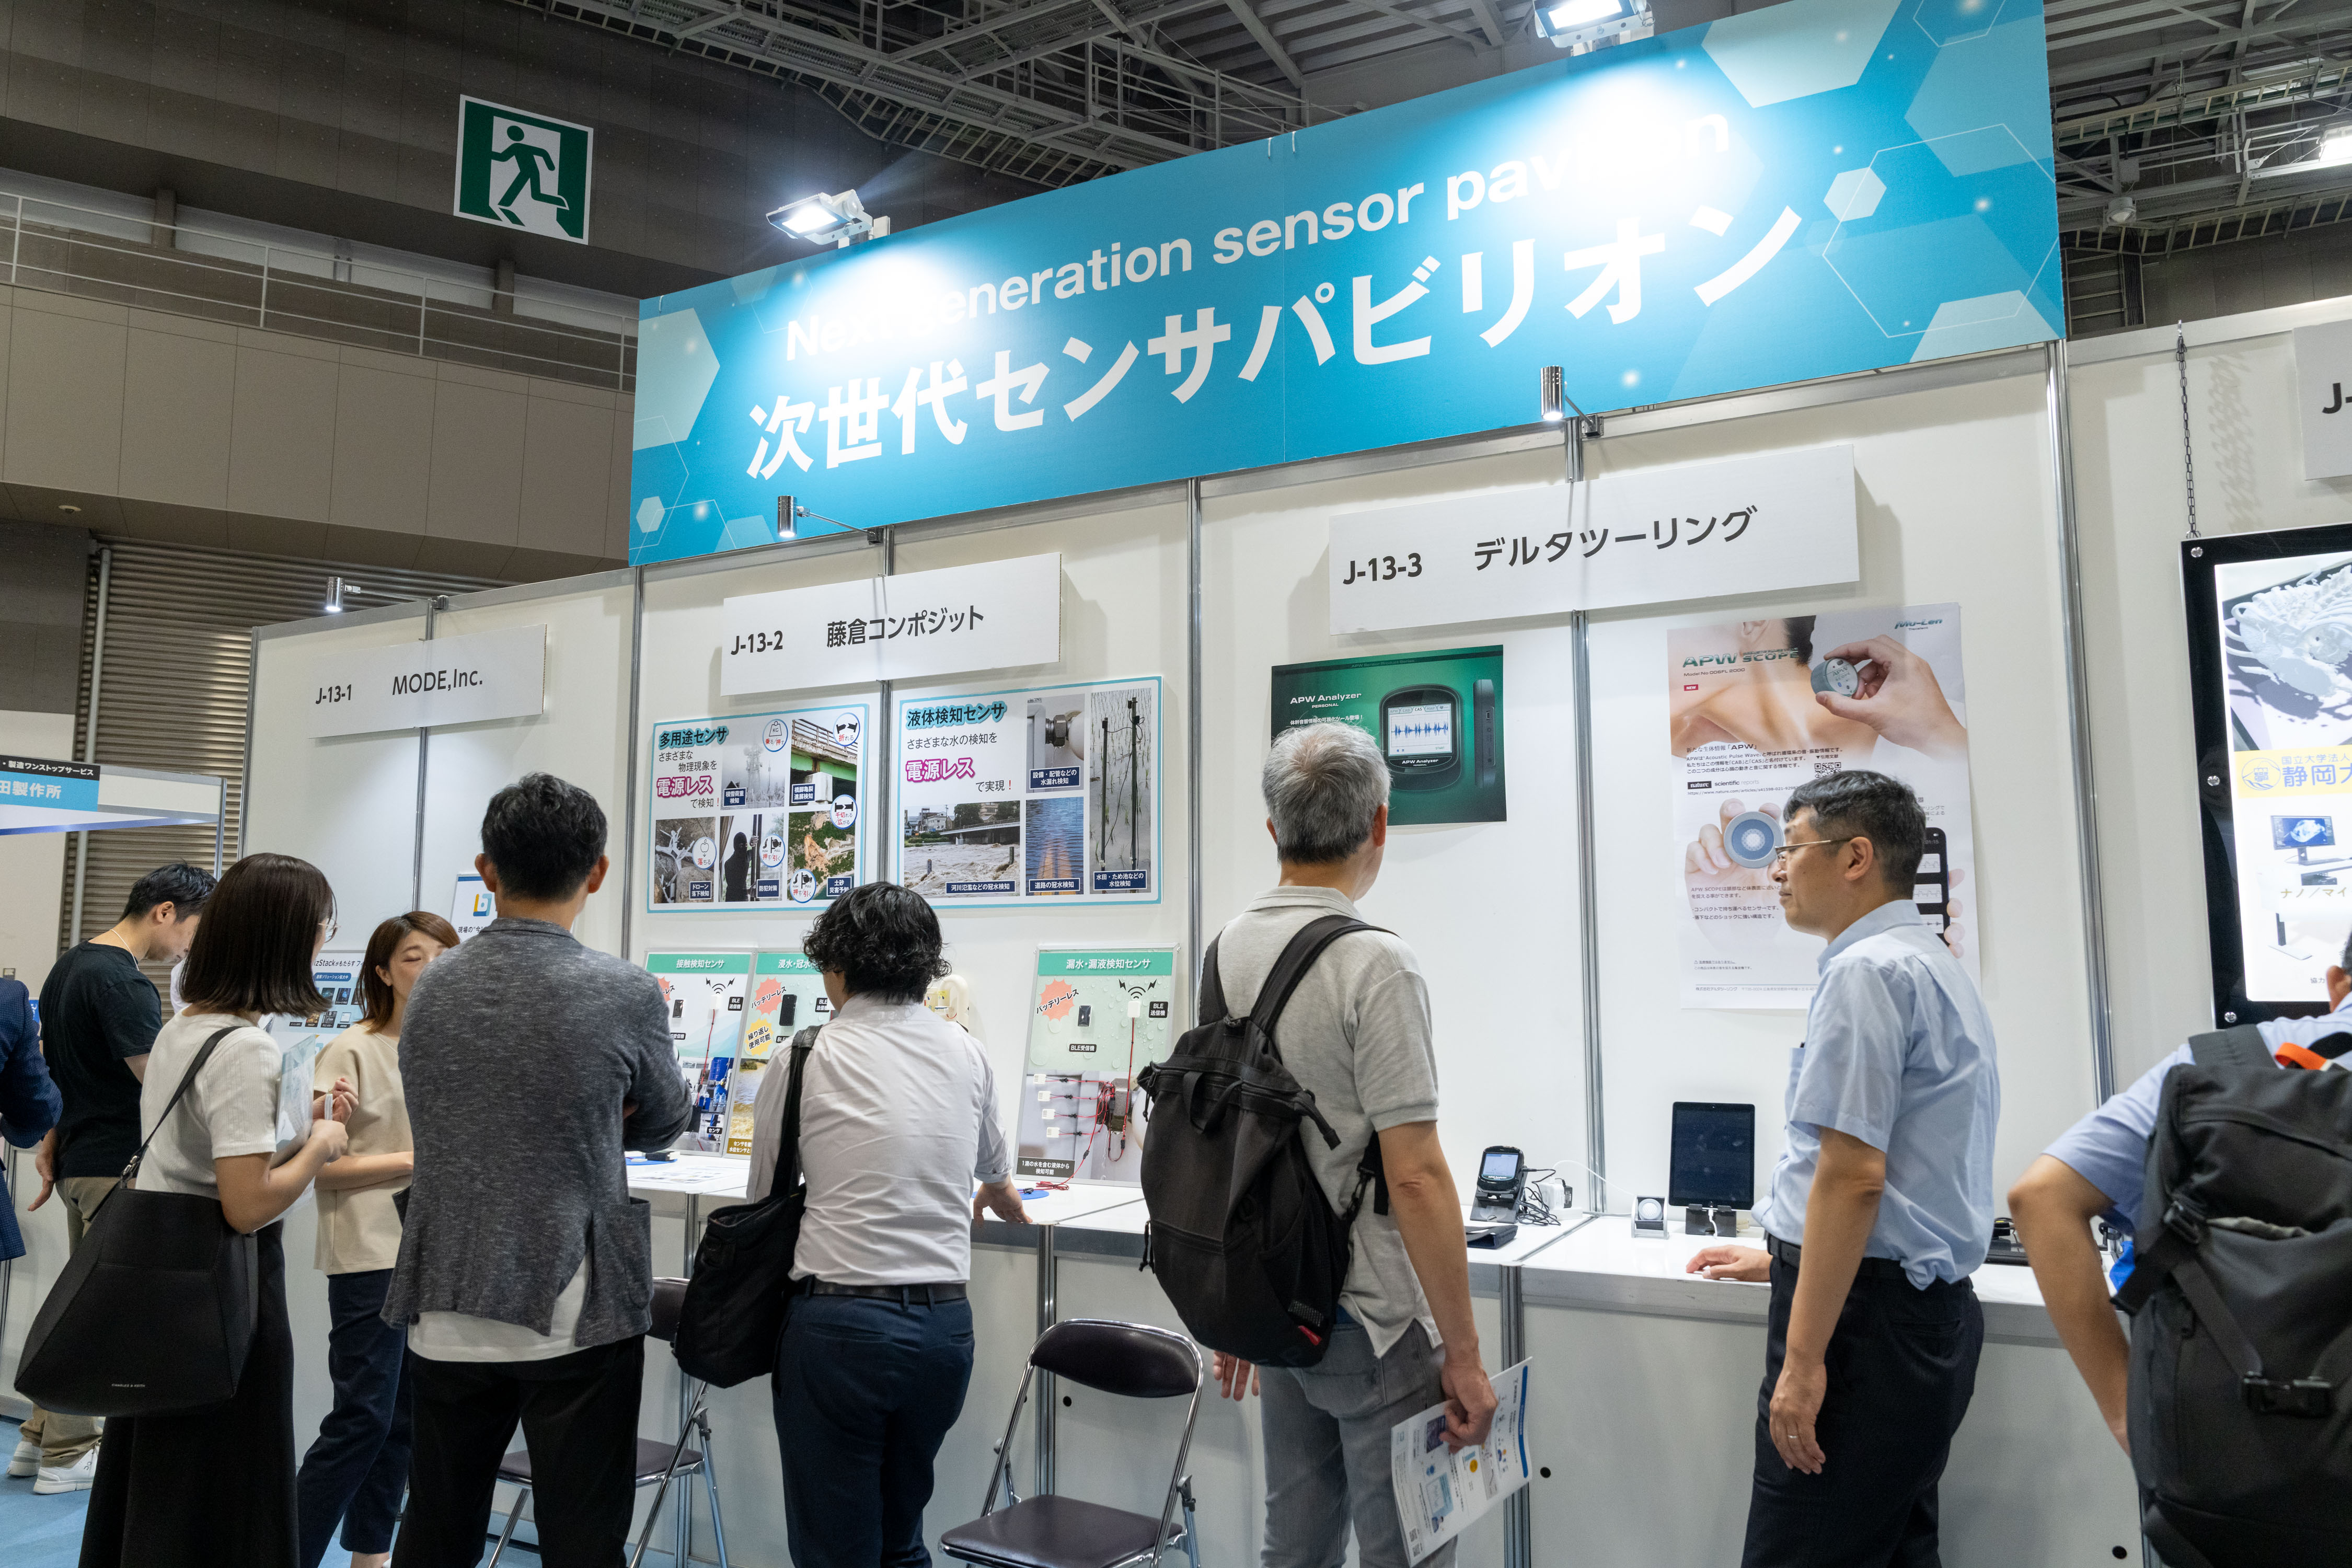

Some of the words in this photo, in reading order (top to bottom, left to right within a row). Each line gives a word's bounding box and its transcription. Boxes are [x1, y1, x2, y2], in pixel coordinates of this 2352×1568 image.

[1213, 181, 1424, 264] sensor
[1448, 113, 1729, 220] pavn
[747, 204, 1803, 481] 次世代センサパビリオン
[1474, 505, 1758, 572] デルタツーリング
[1343, 552, 1423, 585] J-13-3
[826, 605, 984, 648] 藤倉コンポジット
[731, 630, 783, 655] J-13-2
[1682, 653, 1737, 667] APW
[1743, 651, 1798, 662] SCOPE
[393, 668, 482, 695] MODE,Inc.
[315, 684, 352, 704] J-13-1
[1290, 695, 1316, 704] APW
[1318, 693, 1362, 702] Analyzer
[908, 704, 1004, 727] 液体検知センサ
[660, 728, 727, 748] 多用途センサ
[907, 732, 997, 749] さまざまな水の検知を
[659, 750, 693, 762] さまざまな
[1686, 744, 1756, 753] 新たな生体情報「APW」
[678, 760, 717, 773] 物理現象を
[2281, 753, 2350, 765] 国立大学法人
[907, 758, 974, 781] 電源レス
[1033, 769, 1077, 779] 設備・配管などの
[657, 776, 713, 797] 電源レス
[1041, 777, 1069, 786] 水漏れ検知
[0, 781, 62, 799] 田製作所
[1096, 872, 1144, 881] 水田・ため池などの
[951, 883, 1010, 891] 河川氾濫などの冠水検知
[1034, 881, 1074, 889] 道路の冠水検知
[676, 959, 724, 969] 接触検知センサ
[1066, 958, 1150, 970] 漏水・漏液検知センサ
[751, 986, 787, 1008] バッテリーレス
[1036, 988, 1079, 1014] バッテリーレス
[748, 1026, 769, 1041] 繰り返し
[748, 1033, 771, 1049] 使用可能
[1022, 1160, 1070, 1169] 1滴の水を含む液体から
